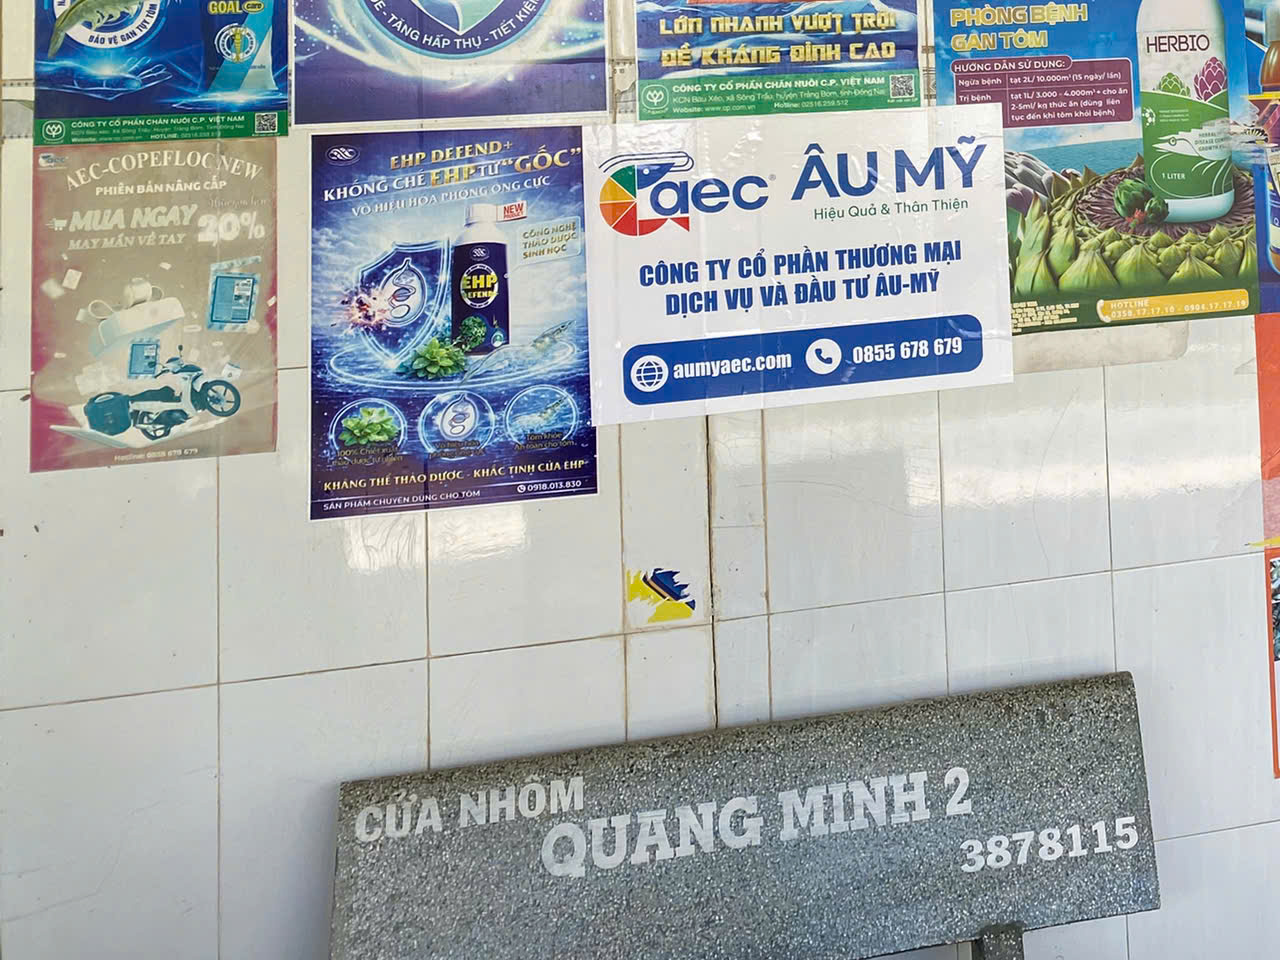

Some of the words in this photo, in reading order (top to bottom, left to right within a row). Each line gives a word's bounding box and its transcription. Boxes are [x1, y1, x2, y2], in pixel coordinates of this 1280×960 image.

[660, 17, 702, 35] LỚN
[711, 15, 782, 33] NHANH
[791, 13, 843, 35] VƯỢT
[950, 4, 1027, 27] PHÒNG
[1030, 2, 1088, 26] BỆNH
[387, 13, 420, 41] TĂNG
[423, 34, 450, 49] HẤP
[454, 36, 481, 49] THỤ
[951, 33, 996, 52] GAN
[999, 29, 1048, 49] TÔM
[1145, 34, 1210, 53] HERBIO
[218, 156, 263, 180] NEW
[390, 153, 426, 170] EHP
[791, 143, 877, 201] ÂU
[894, 136, 988, 194] MỸ
[69, 208, 125, 232] MUA
[130, 203, 198, 229] NGAY
[504, 203, 524, 213] NEW
[814, 206, 845, 221] Hiệu
[848, 202, 877, 219] Quả
[880, 204, 891, 216] &
[895, 199, 929, 214] Thân
[932, 197, 969, 213] Thiện
[639, 256, 699, 287] CÔNG
[705, 259, 731, 281] TY
[738, 248, 767, 279] CỔ
[774, 244, 829, 275] PHẦN
[836, 242, 917, 271] THƯƠNG
[924, 239, 961, 266] MẠI
[665, 290, 718, 319] DỊCH
[725, 287, 752, 313] VỤ
[760, 280, 788, 307] VÀ
[794, 272, 837, 304] ĐẦU
[843, 274, 872, 299] TƯ
[875, 268, 940, 297] ÂU-MỸ
[852, 342, 896, 365] 0855
[899, 339, 930, 361] 678
[934, 337, 963, 357] 679
[673, 352, 792, 380] aumyaec.com
[527, 480, 582, 492] 0918.013.830
[355, 790, 443, 842] CỬA
[459, 775, 584, 828] NHÔM
[541, 796, 762, 878] QUANG
[779, 771, 930, 841] MINH
[945, 766, 973, 816] 2
[960, 816, 1140, 874] 3878115
